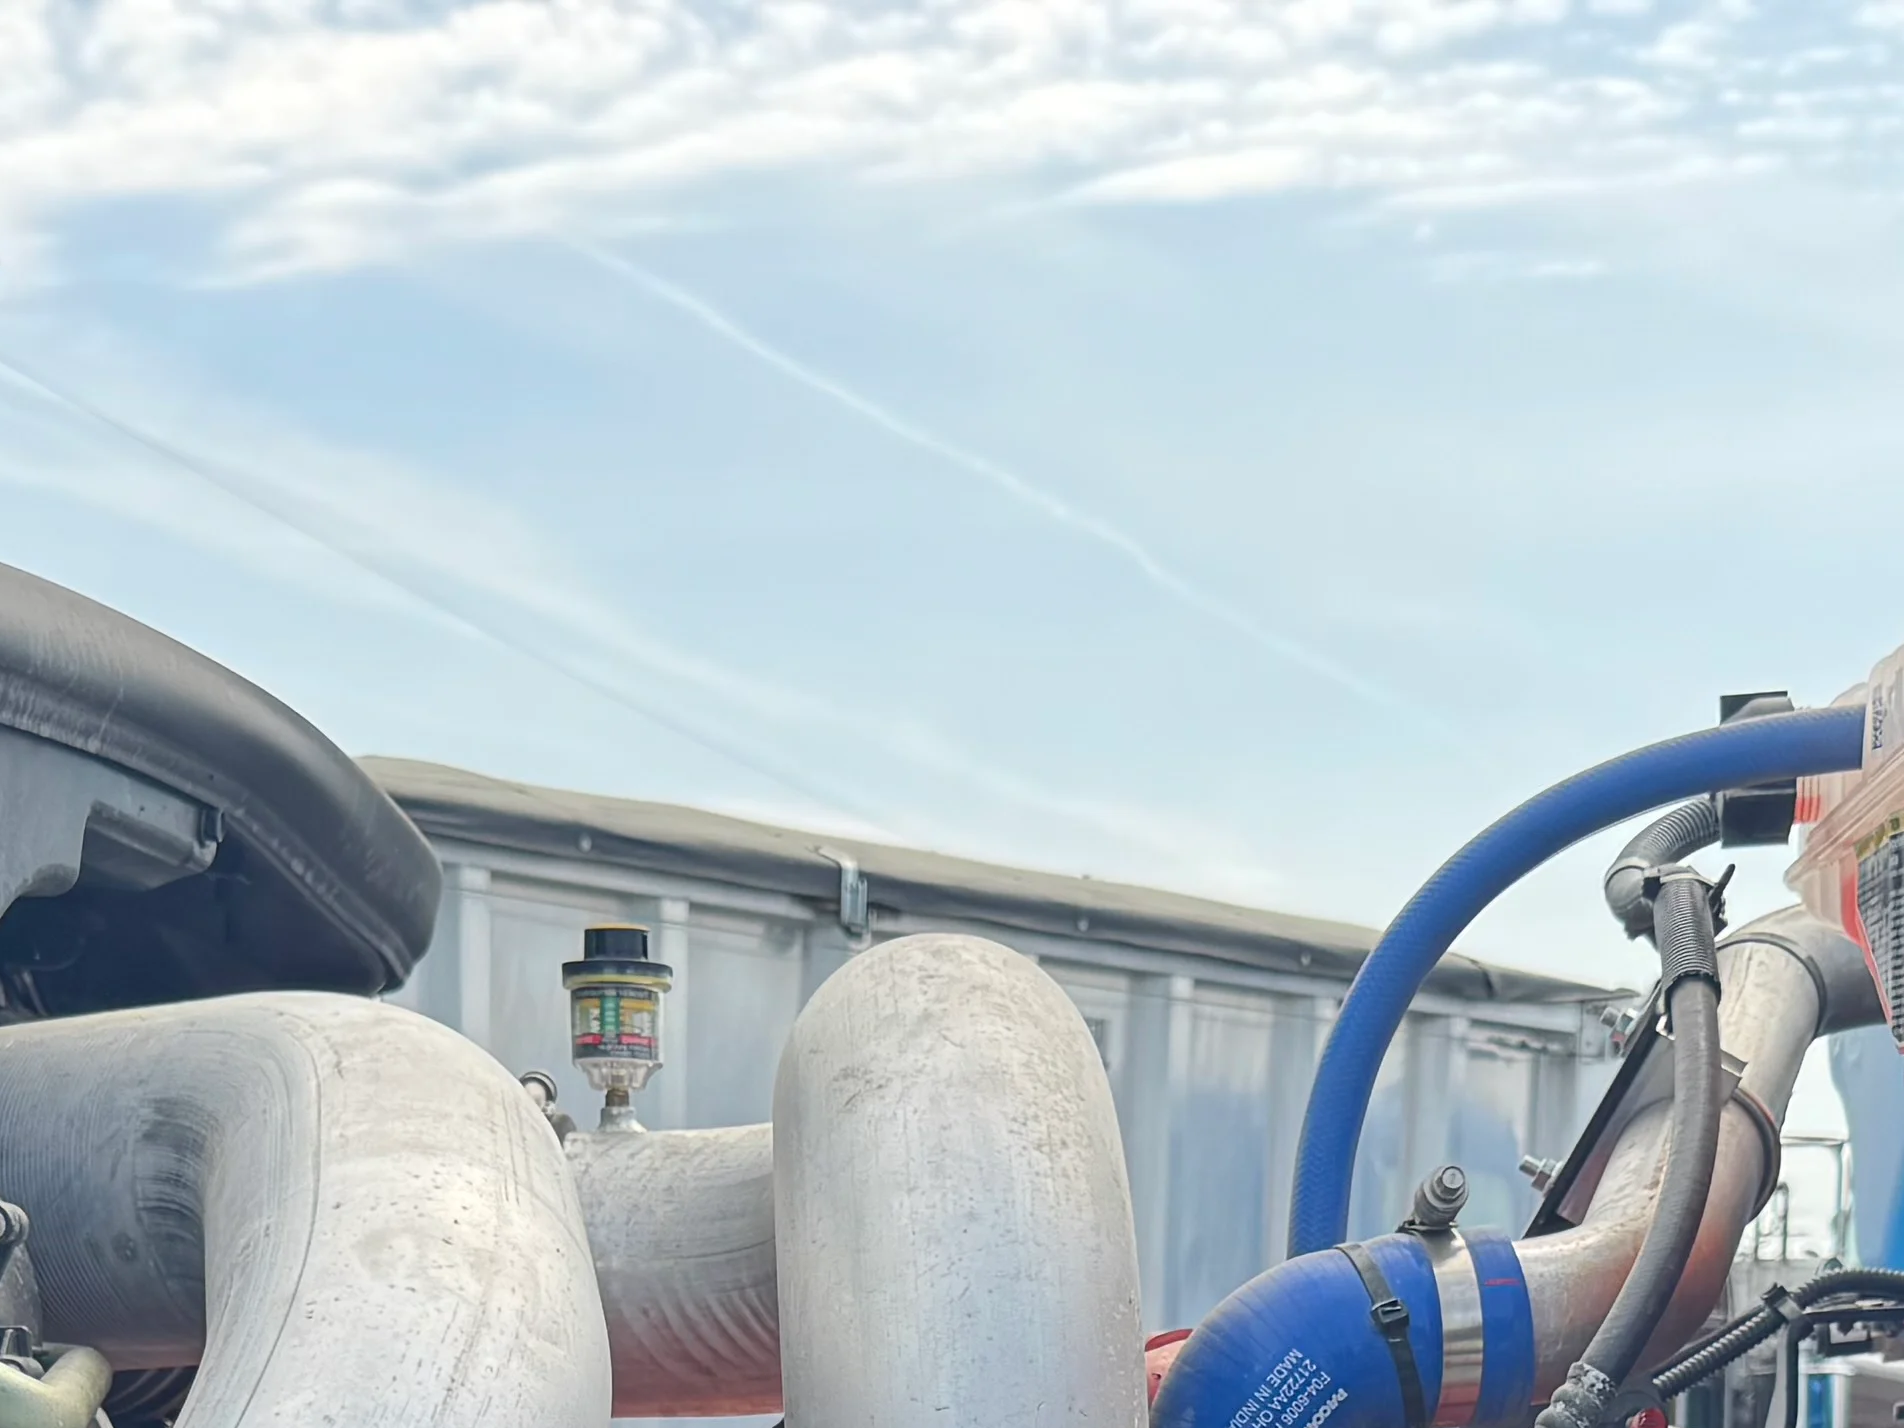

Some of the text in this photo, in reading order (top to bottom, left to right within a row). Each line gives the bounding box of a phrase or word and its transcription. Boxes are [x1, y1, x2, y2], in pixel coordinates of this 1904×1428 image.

[1266, 1348, 1303, 1387] MADE
[1268, 1359, 1317, 1410] 21722AA
[1254, 1384, 1272, 1402] IN
[1280, 1371, 1331, 1425] F04-6006
